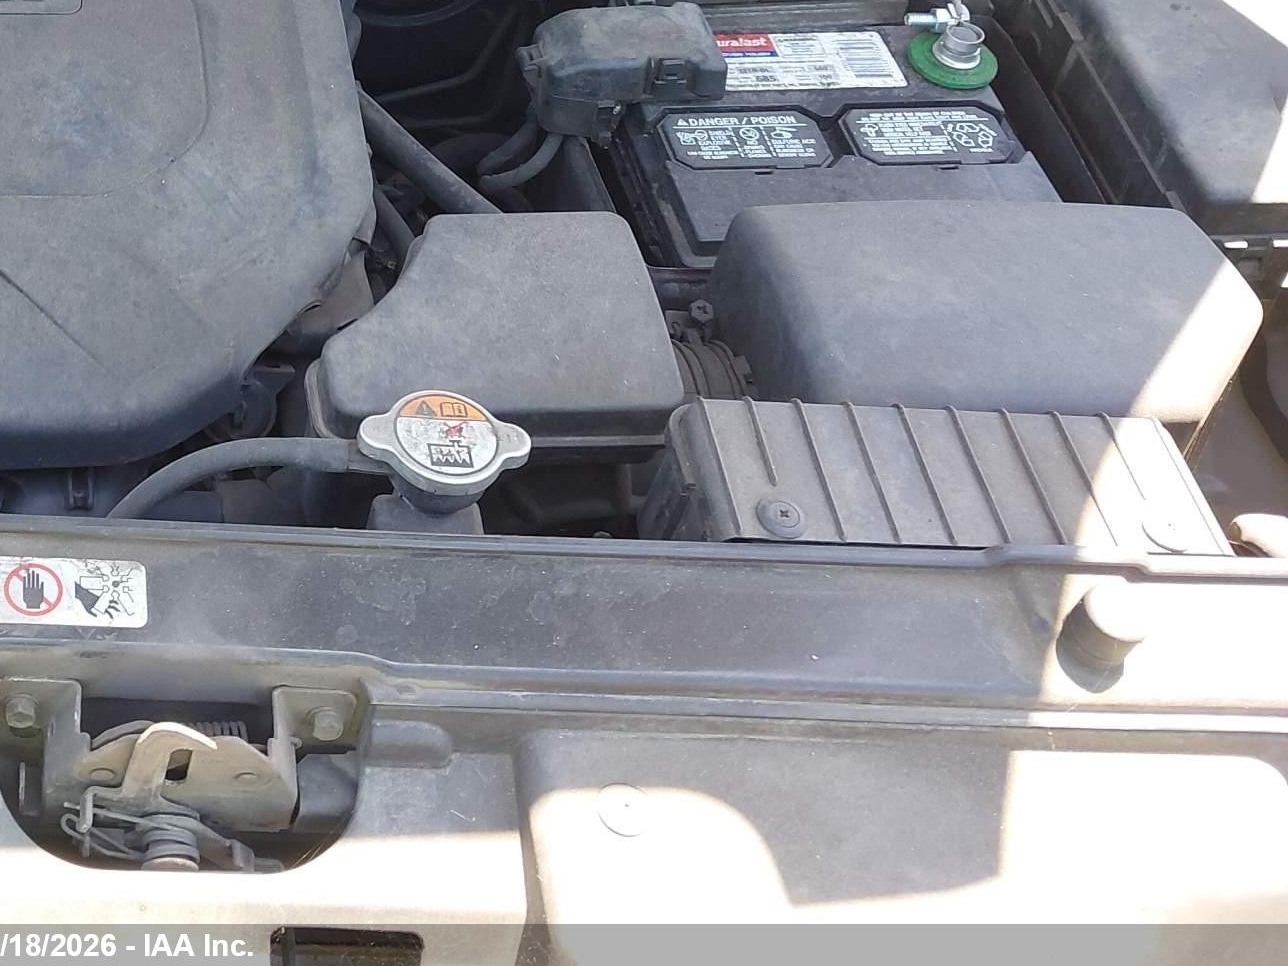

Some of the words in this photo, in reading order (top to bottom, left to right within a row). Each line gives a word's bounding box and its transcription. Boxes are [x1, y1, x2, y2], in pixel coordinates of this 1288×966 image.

[715, 36, 768, 47] uralast
[688, 116, 739, 127] DANGER
[751, 115, 797, 125] POISON
